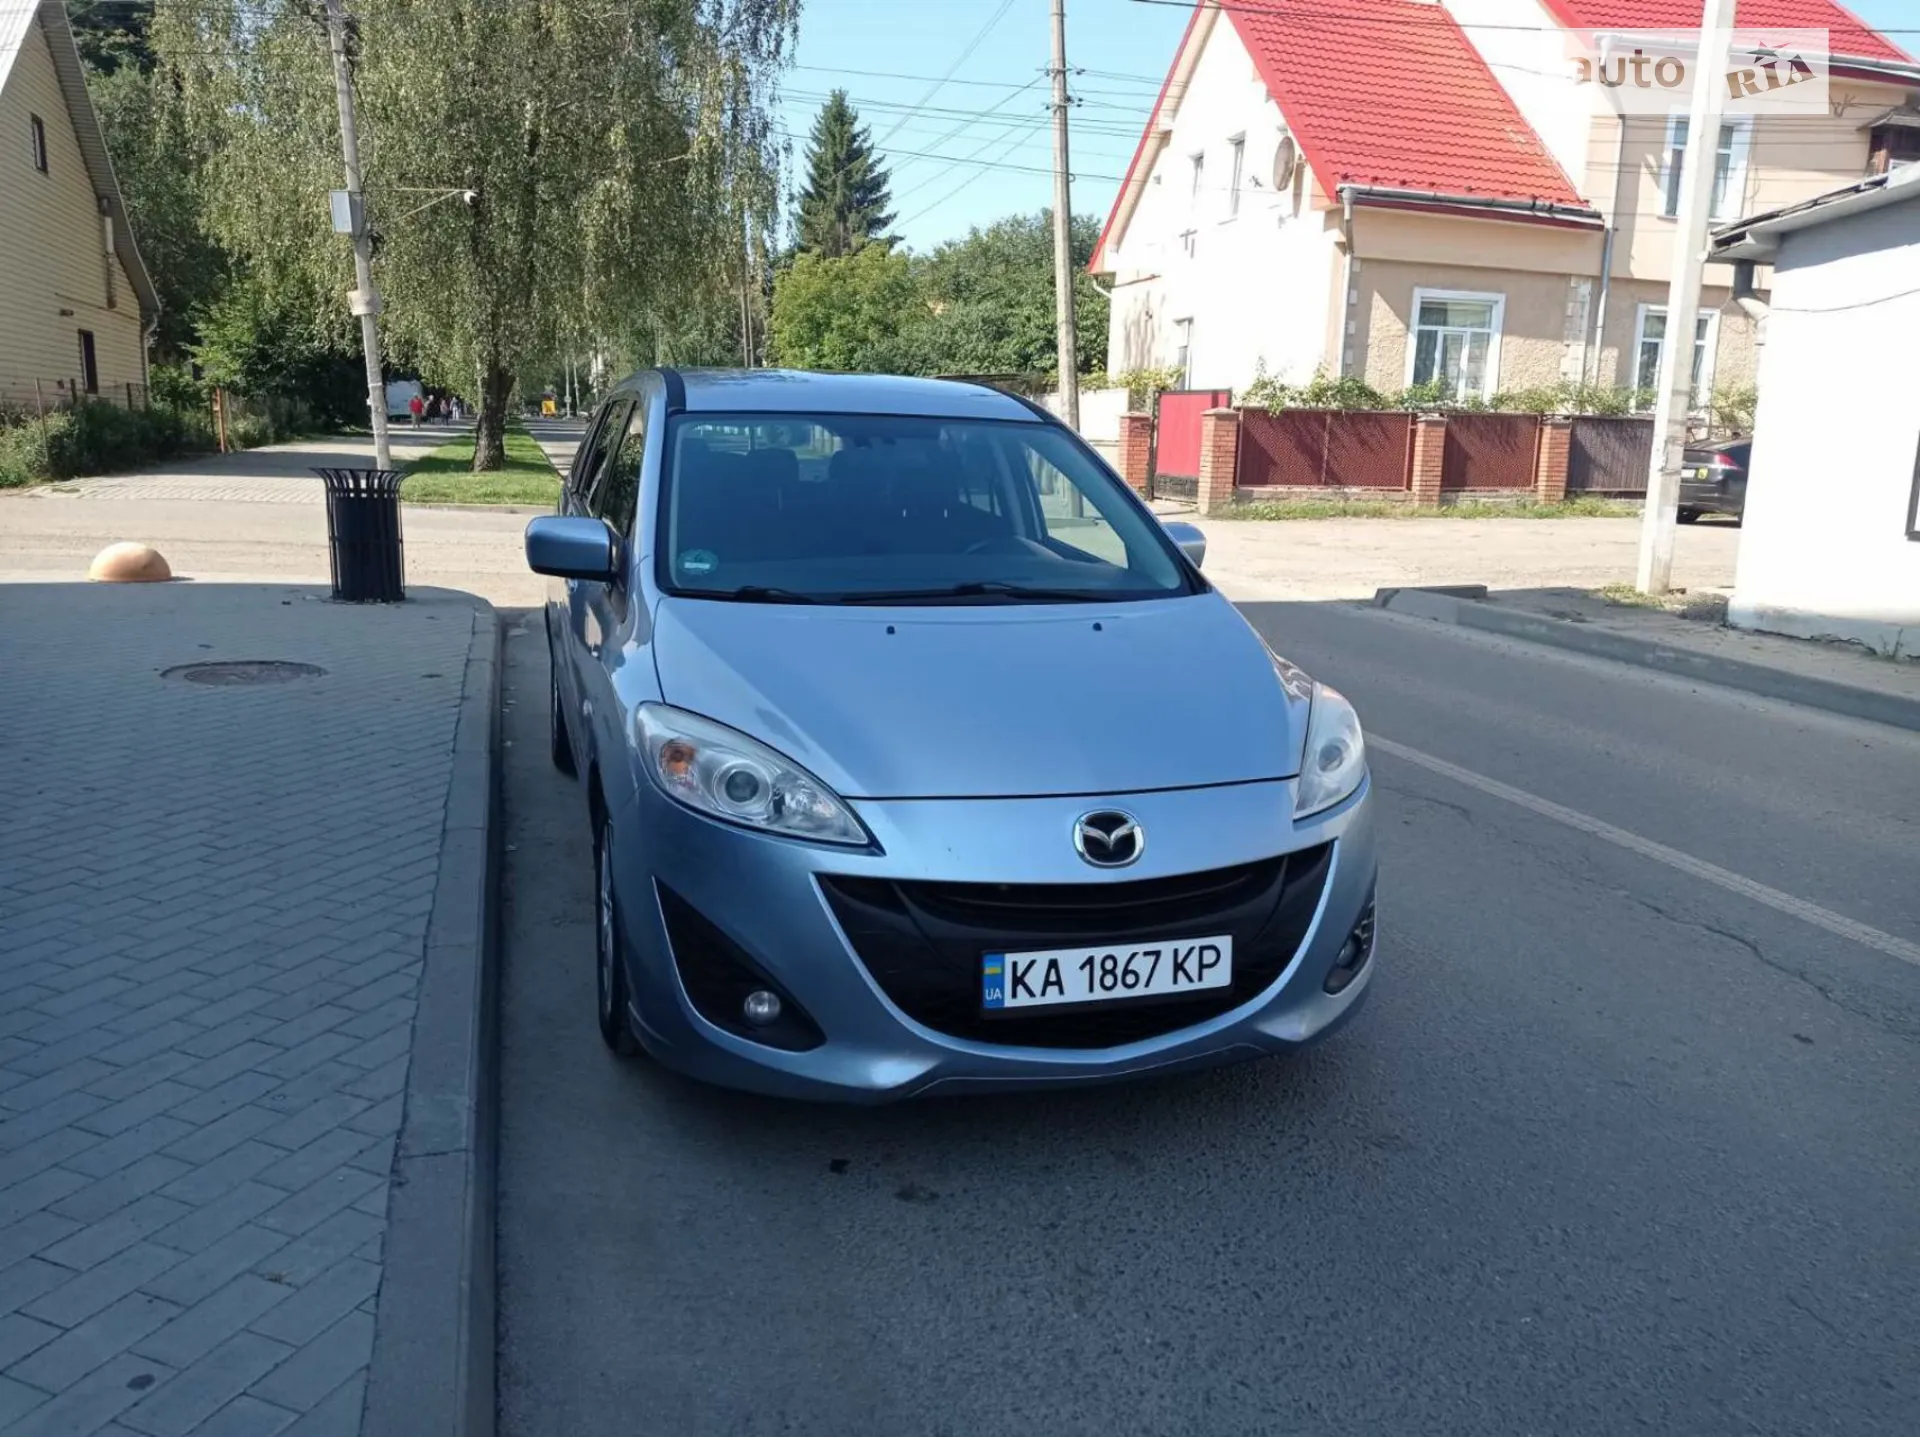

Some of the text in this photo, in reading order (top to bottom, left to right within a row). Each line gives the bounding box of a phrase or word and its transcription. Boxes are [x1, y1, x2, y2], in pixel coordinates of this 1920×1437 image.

[1011, 944, 1221, 999] KA 1867 KP
[985, 988, 1002, 1001] UA
